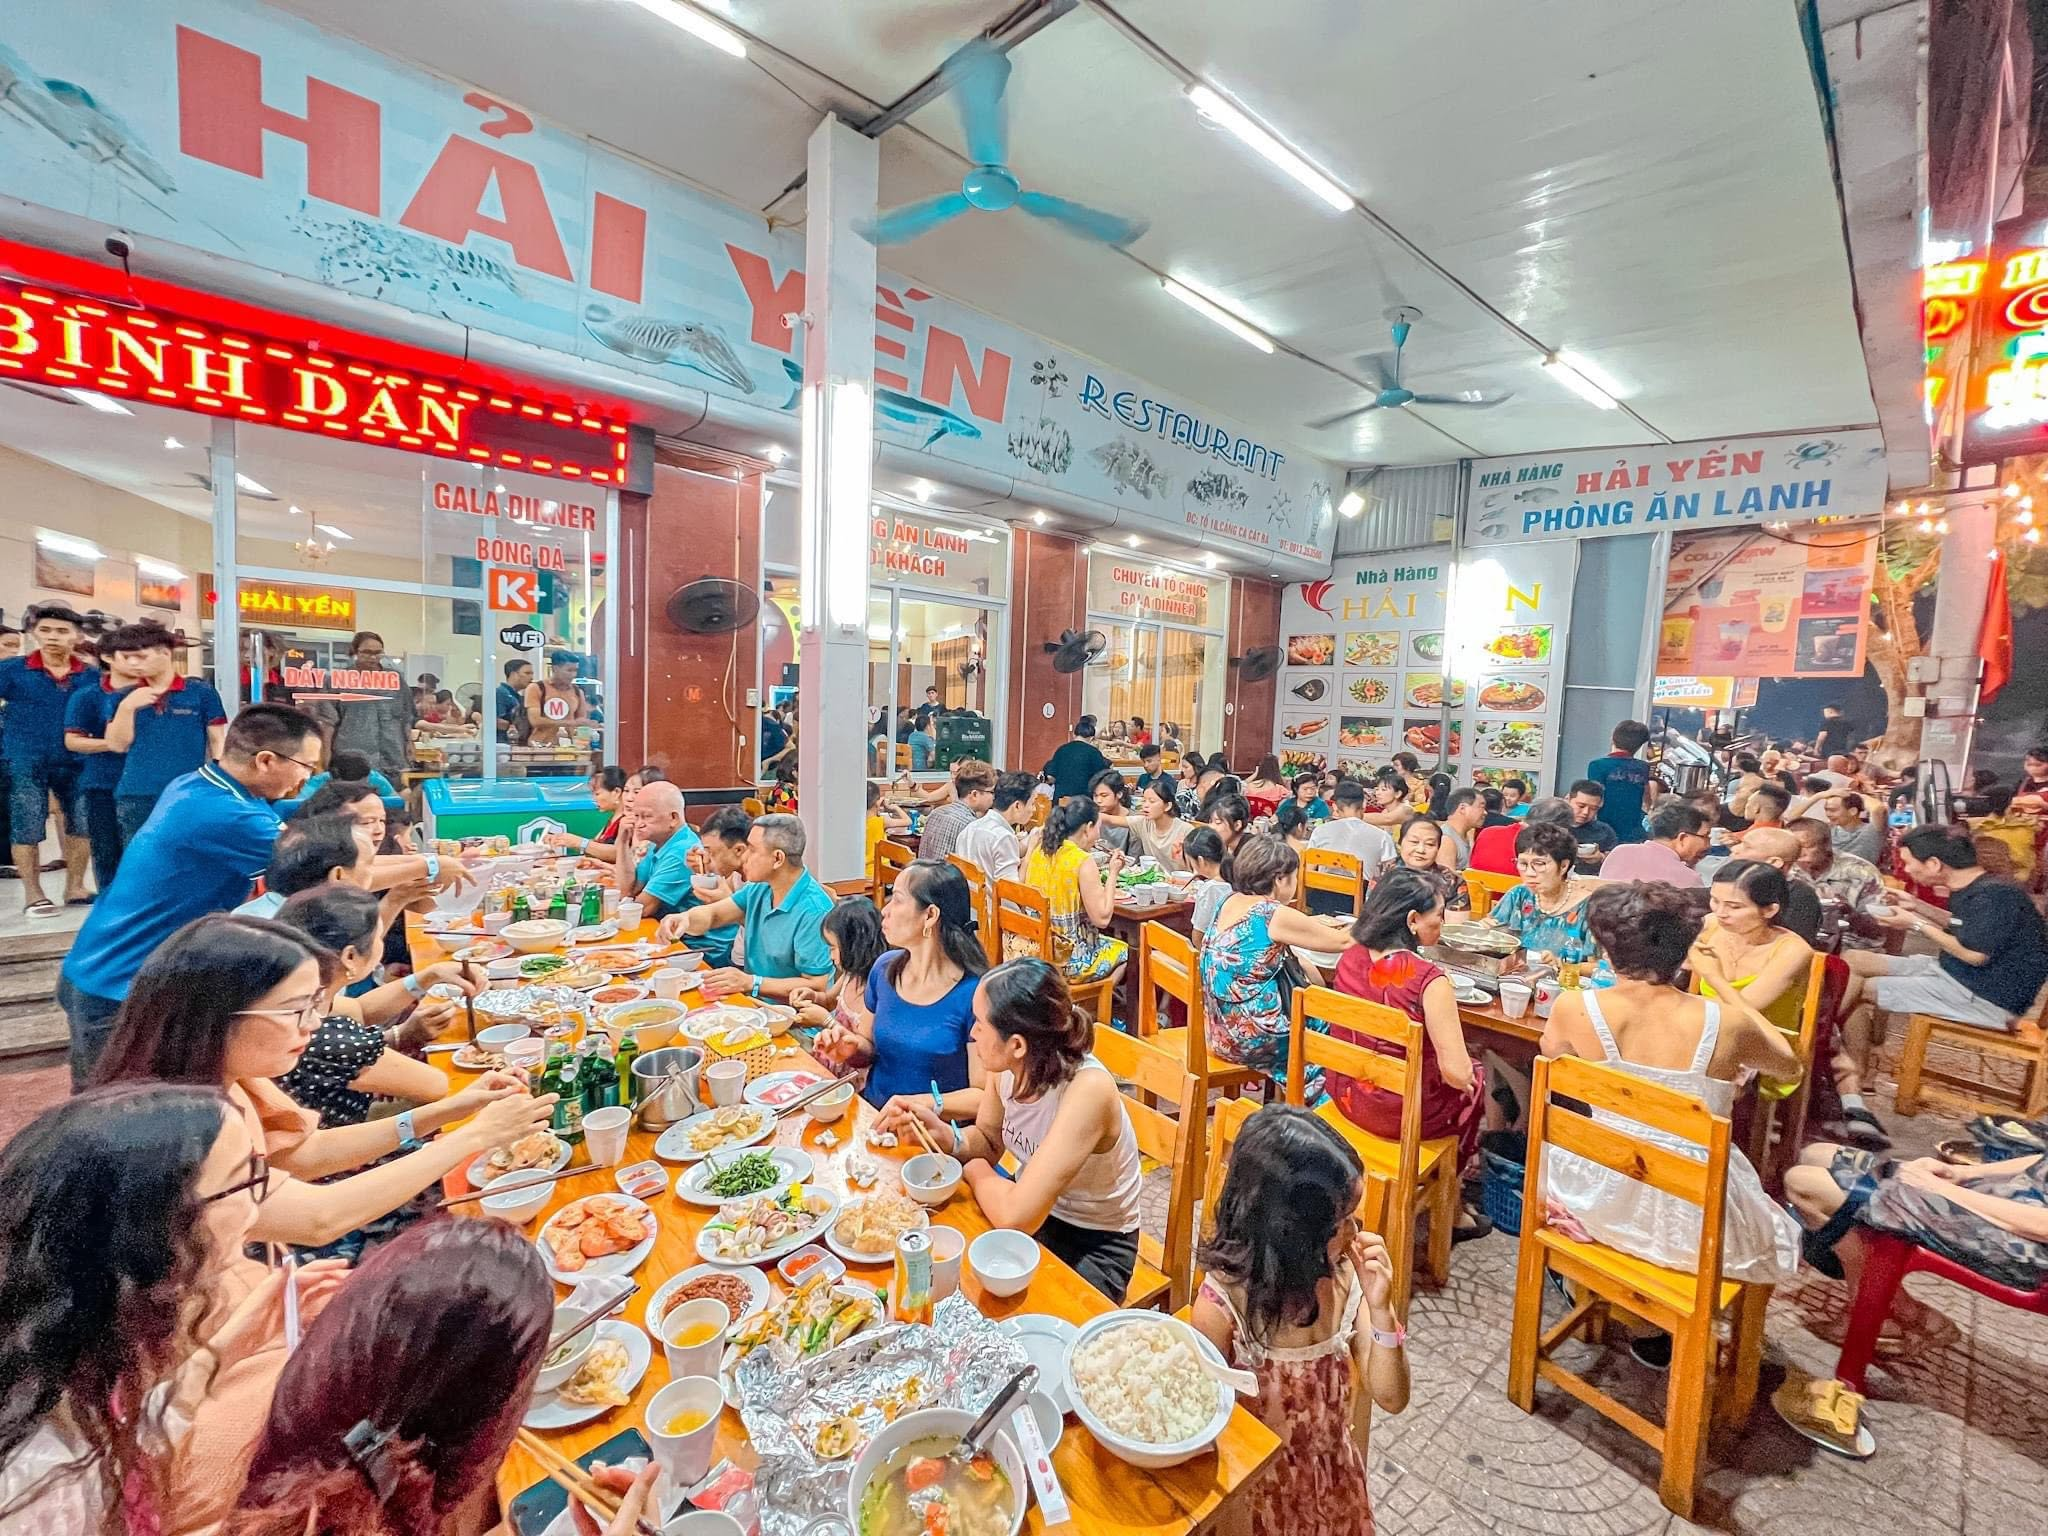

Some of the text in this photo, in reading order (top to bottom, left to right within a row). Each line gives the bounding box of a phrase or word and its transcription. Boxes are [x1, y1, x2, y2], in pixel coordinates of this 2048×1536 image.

[176, 23, 646, 303] HẢI
[1078, 374, 1285, 480] RESTAURANT
[1479, 462, 1563, 488] NHÀ HÀNG
[1576, 444, 1764, 494] HẢI YẾN
[434, 482, 596, 532] GALA DINNER
[1522, 479, 1831, 534] PHÒNG ĂN LẠNH
[892, 517, 919, 544] ĂN
[923, 528, 969, 554] LẠNH
[497, 574, 547, 609] K+
[1356, 566, 1438, 584] Nhà Hàng
[1154, 597, 1196, 617] DINNER
[1340, 586, 1418, 621] HẢI
[331, 670, 400, 690] NGANG
